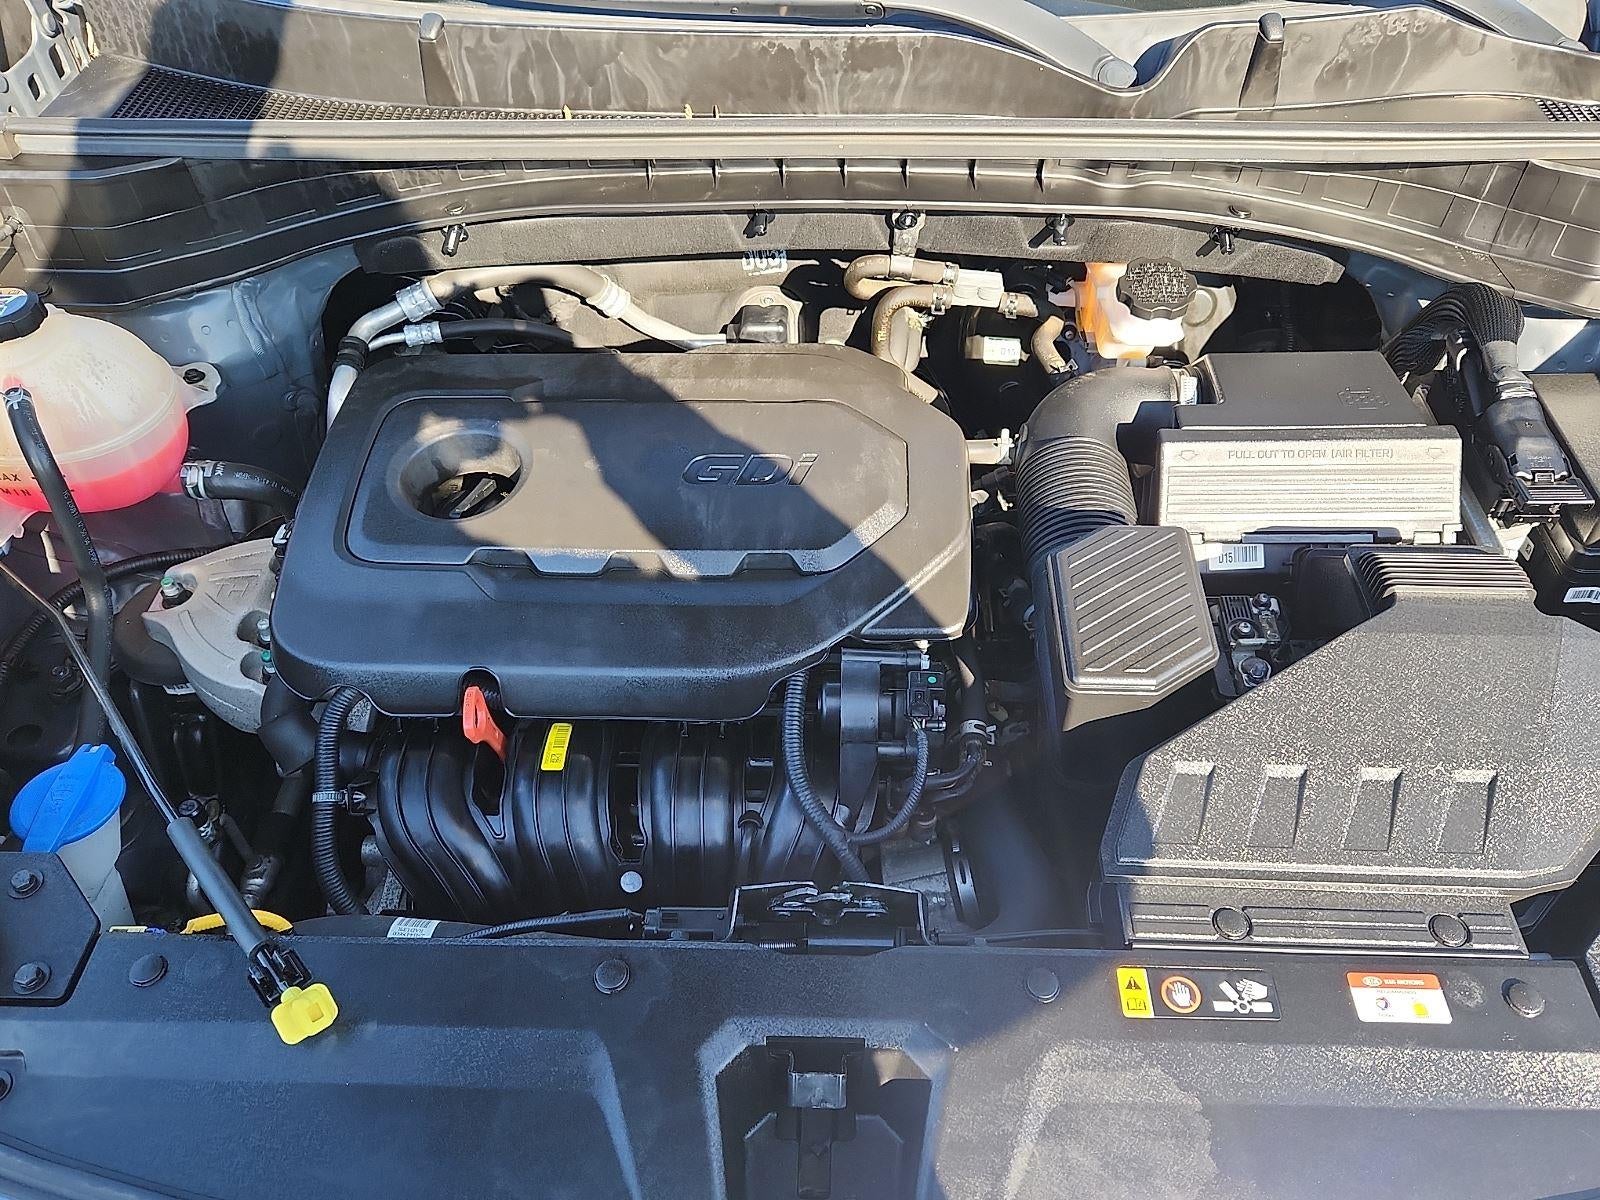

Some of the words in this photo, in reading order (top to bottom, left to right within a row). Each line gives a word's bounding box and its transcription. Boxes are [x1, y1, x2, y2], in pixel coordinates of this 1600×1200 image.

[1228, 449, 1255, 459] PULL
[1257, 449, 1279, 459] OUT
[1281, 449, 1295, 459] TO
[1298, 449, 1327, 459] OPEN
[1331, 448, 1353, 459] (AIR
[1355, 448, 1393, 459] FILTER)
[681, 453, 819, 485] GDi
[0, 473, 21, 481] AX
